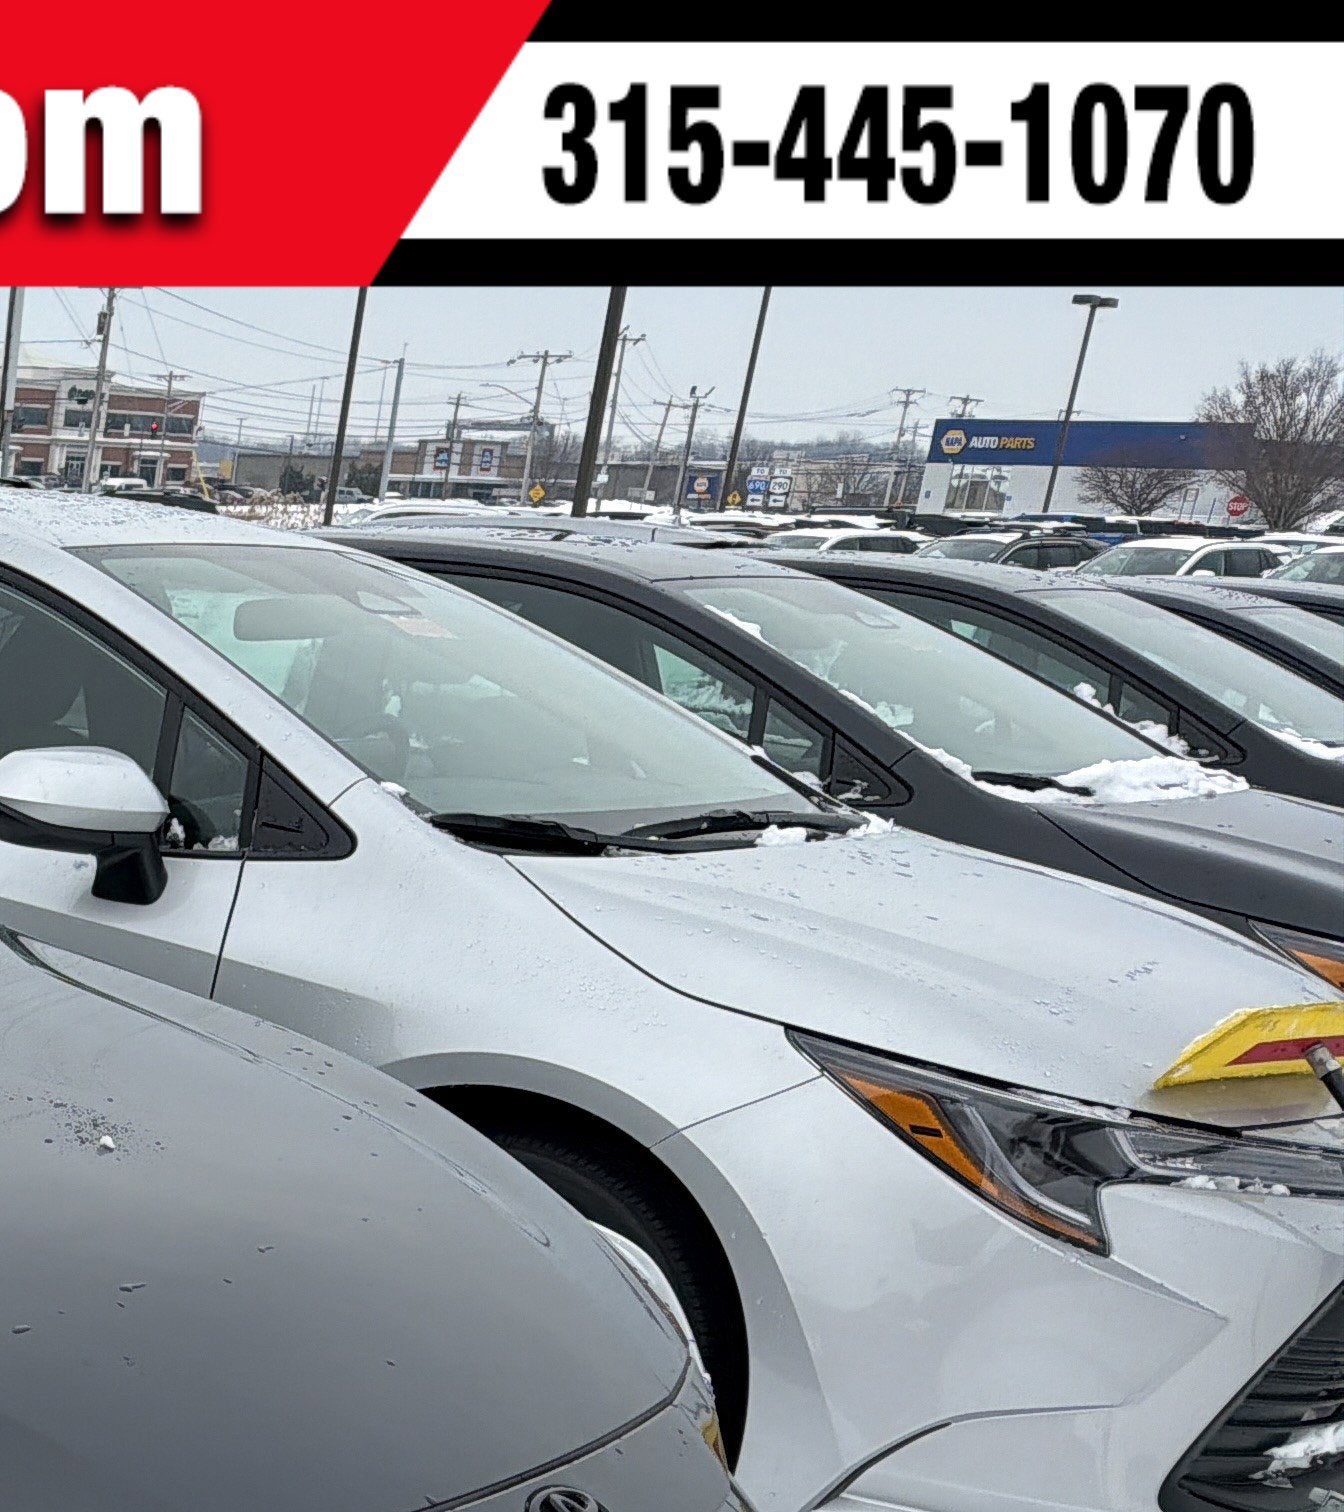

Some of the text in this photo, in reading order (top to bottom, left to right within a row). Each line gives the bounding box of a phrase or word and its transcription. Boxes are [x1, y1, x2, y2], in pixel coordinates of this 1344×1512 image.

[969, 436, 999, 449] AUTO
[999, 436, 1035, 449] PARTS
[748, 480, 767, 490] 690
[772, 481, 788, 491] 290
[1228, 502, 1248, 511] STOP
